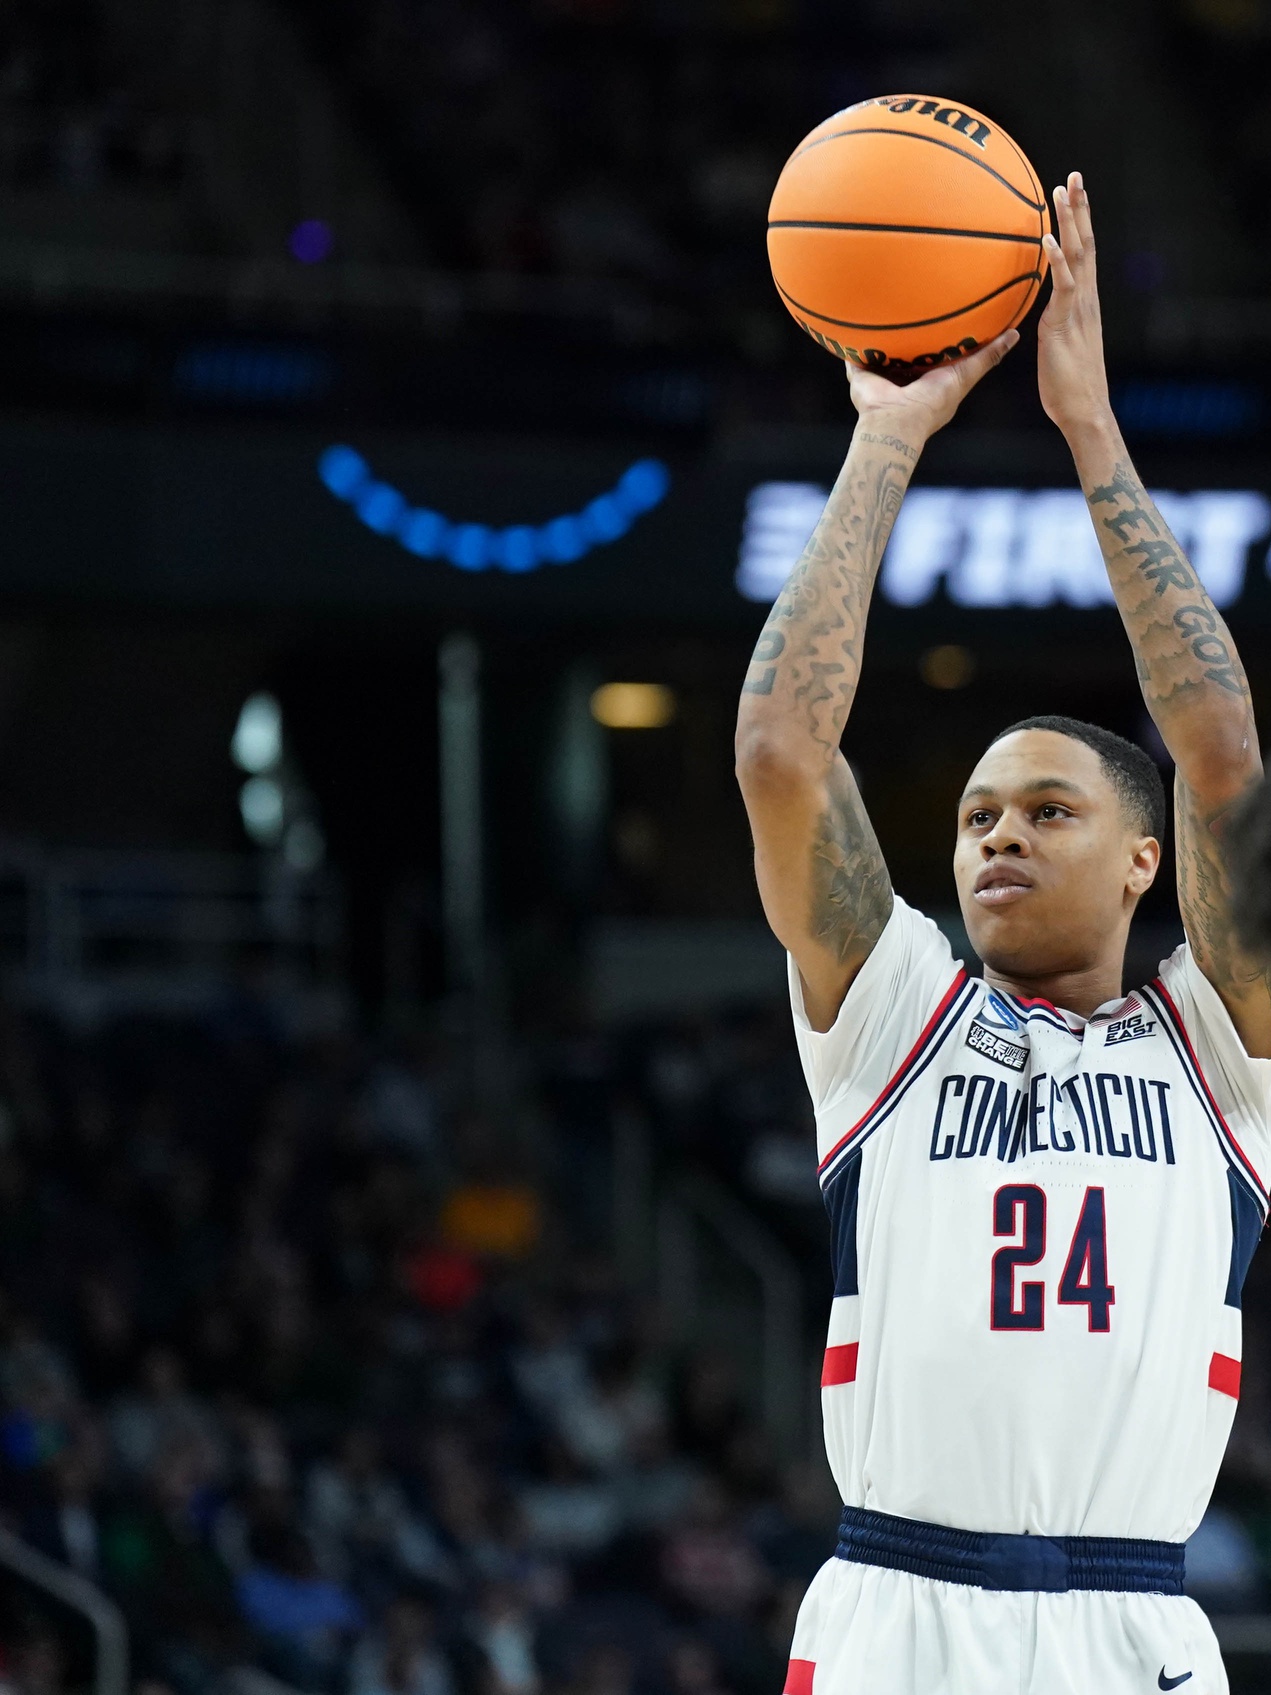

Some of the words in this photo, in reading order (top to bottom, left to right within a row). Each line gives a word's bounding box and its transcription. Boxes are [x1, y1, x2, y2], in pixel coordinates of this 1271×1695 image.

[1087, 483, 1196, 597] FEAR
[1105, 1021, 1157, 1042] EAST
[1107, 1014, 1142, 1033] BIG
[968, 1036, 1024, 1069] CHANGE
[990, 1183, 1116, 1334] 24
